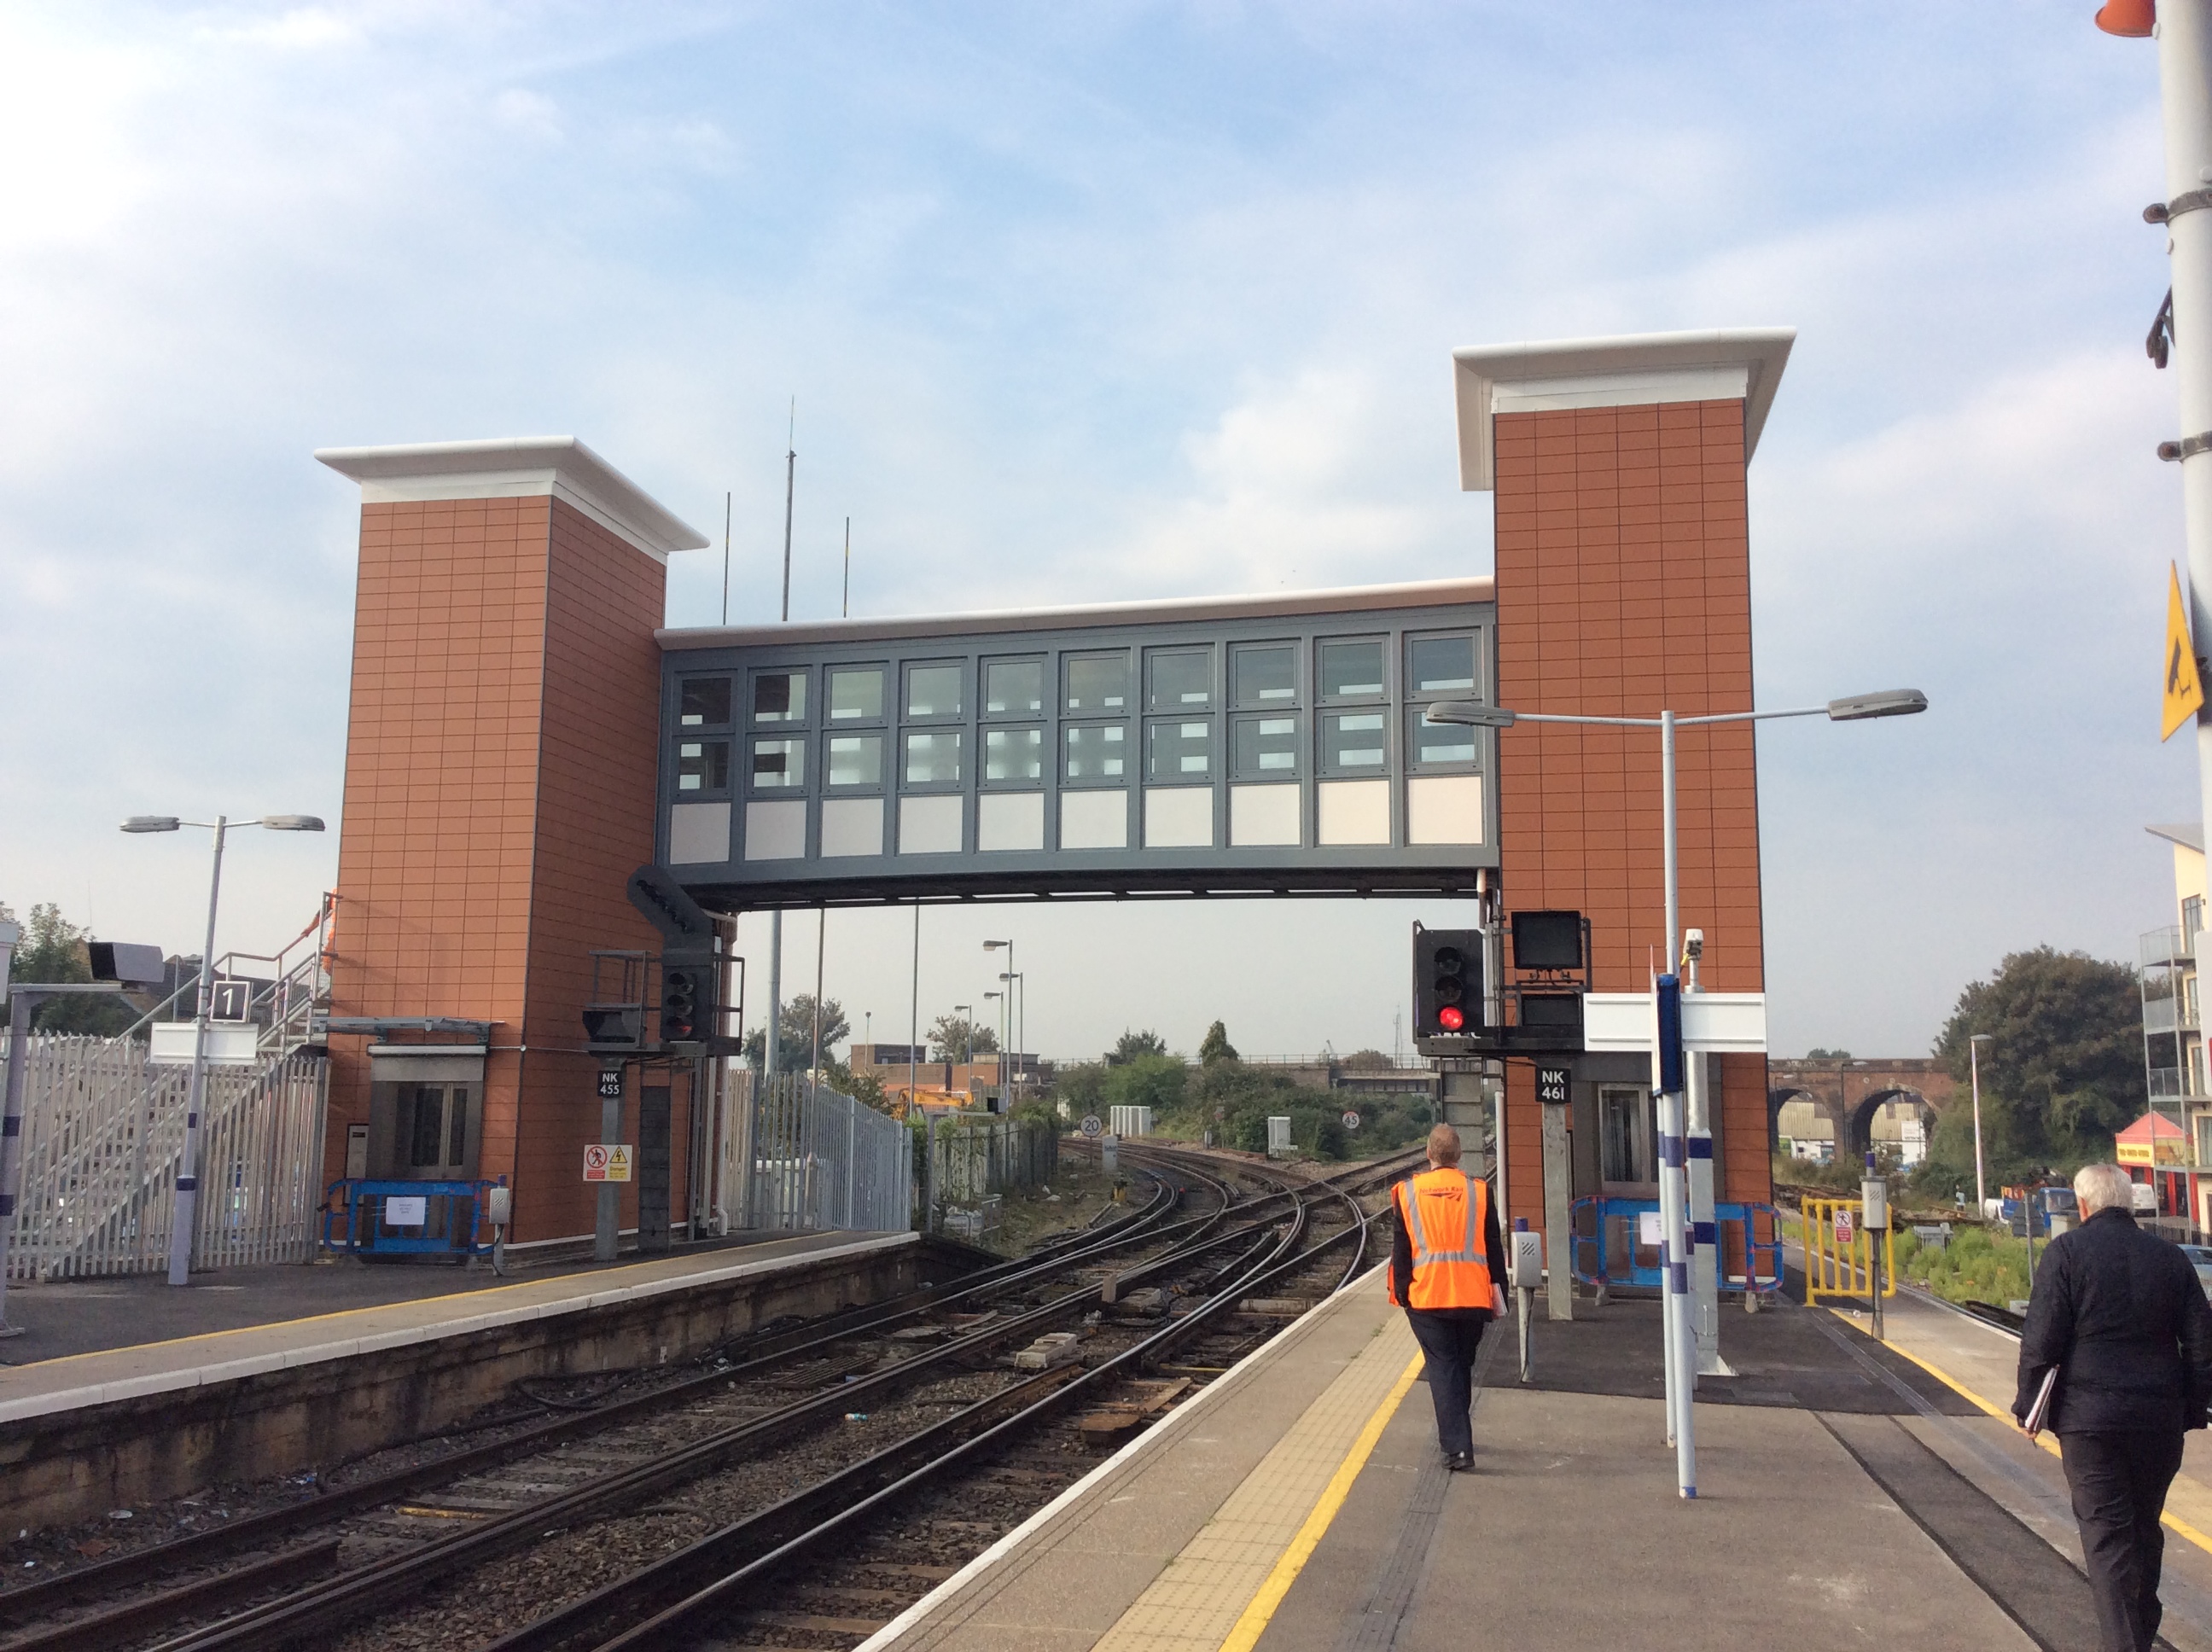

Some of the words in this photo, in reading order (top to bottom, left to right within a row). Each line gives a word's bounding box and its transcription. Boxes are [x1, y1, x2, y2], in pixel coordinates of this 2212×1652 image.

[222, 988, 233, 1015] 1
[602, 1073, 618, 1083] NK
[1542, 1071, 1564, 1083] NK
[600, 1084, 620, 1095] 455
[1542, 1086, 1564, 1100] 461
[1085, 1120, 1099, 1131] 20
[1344, 1115, 1358, 1126] 45
